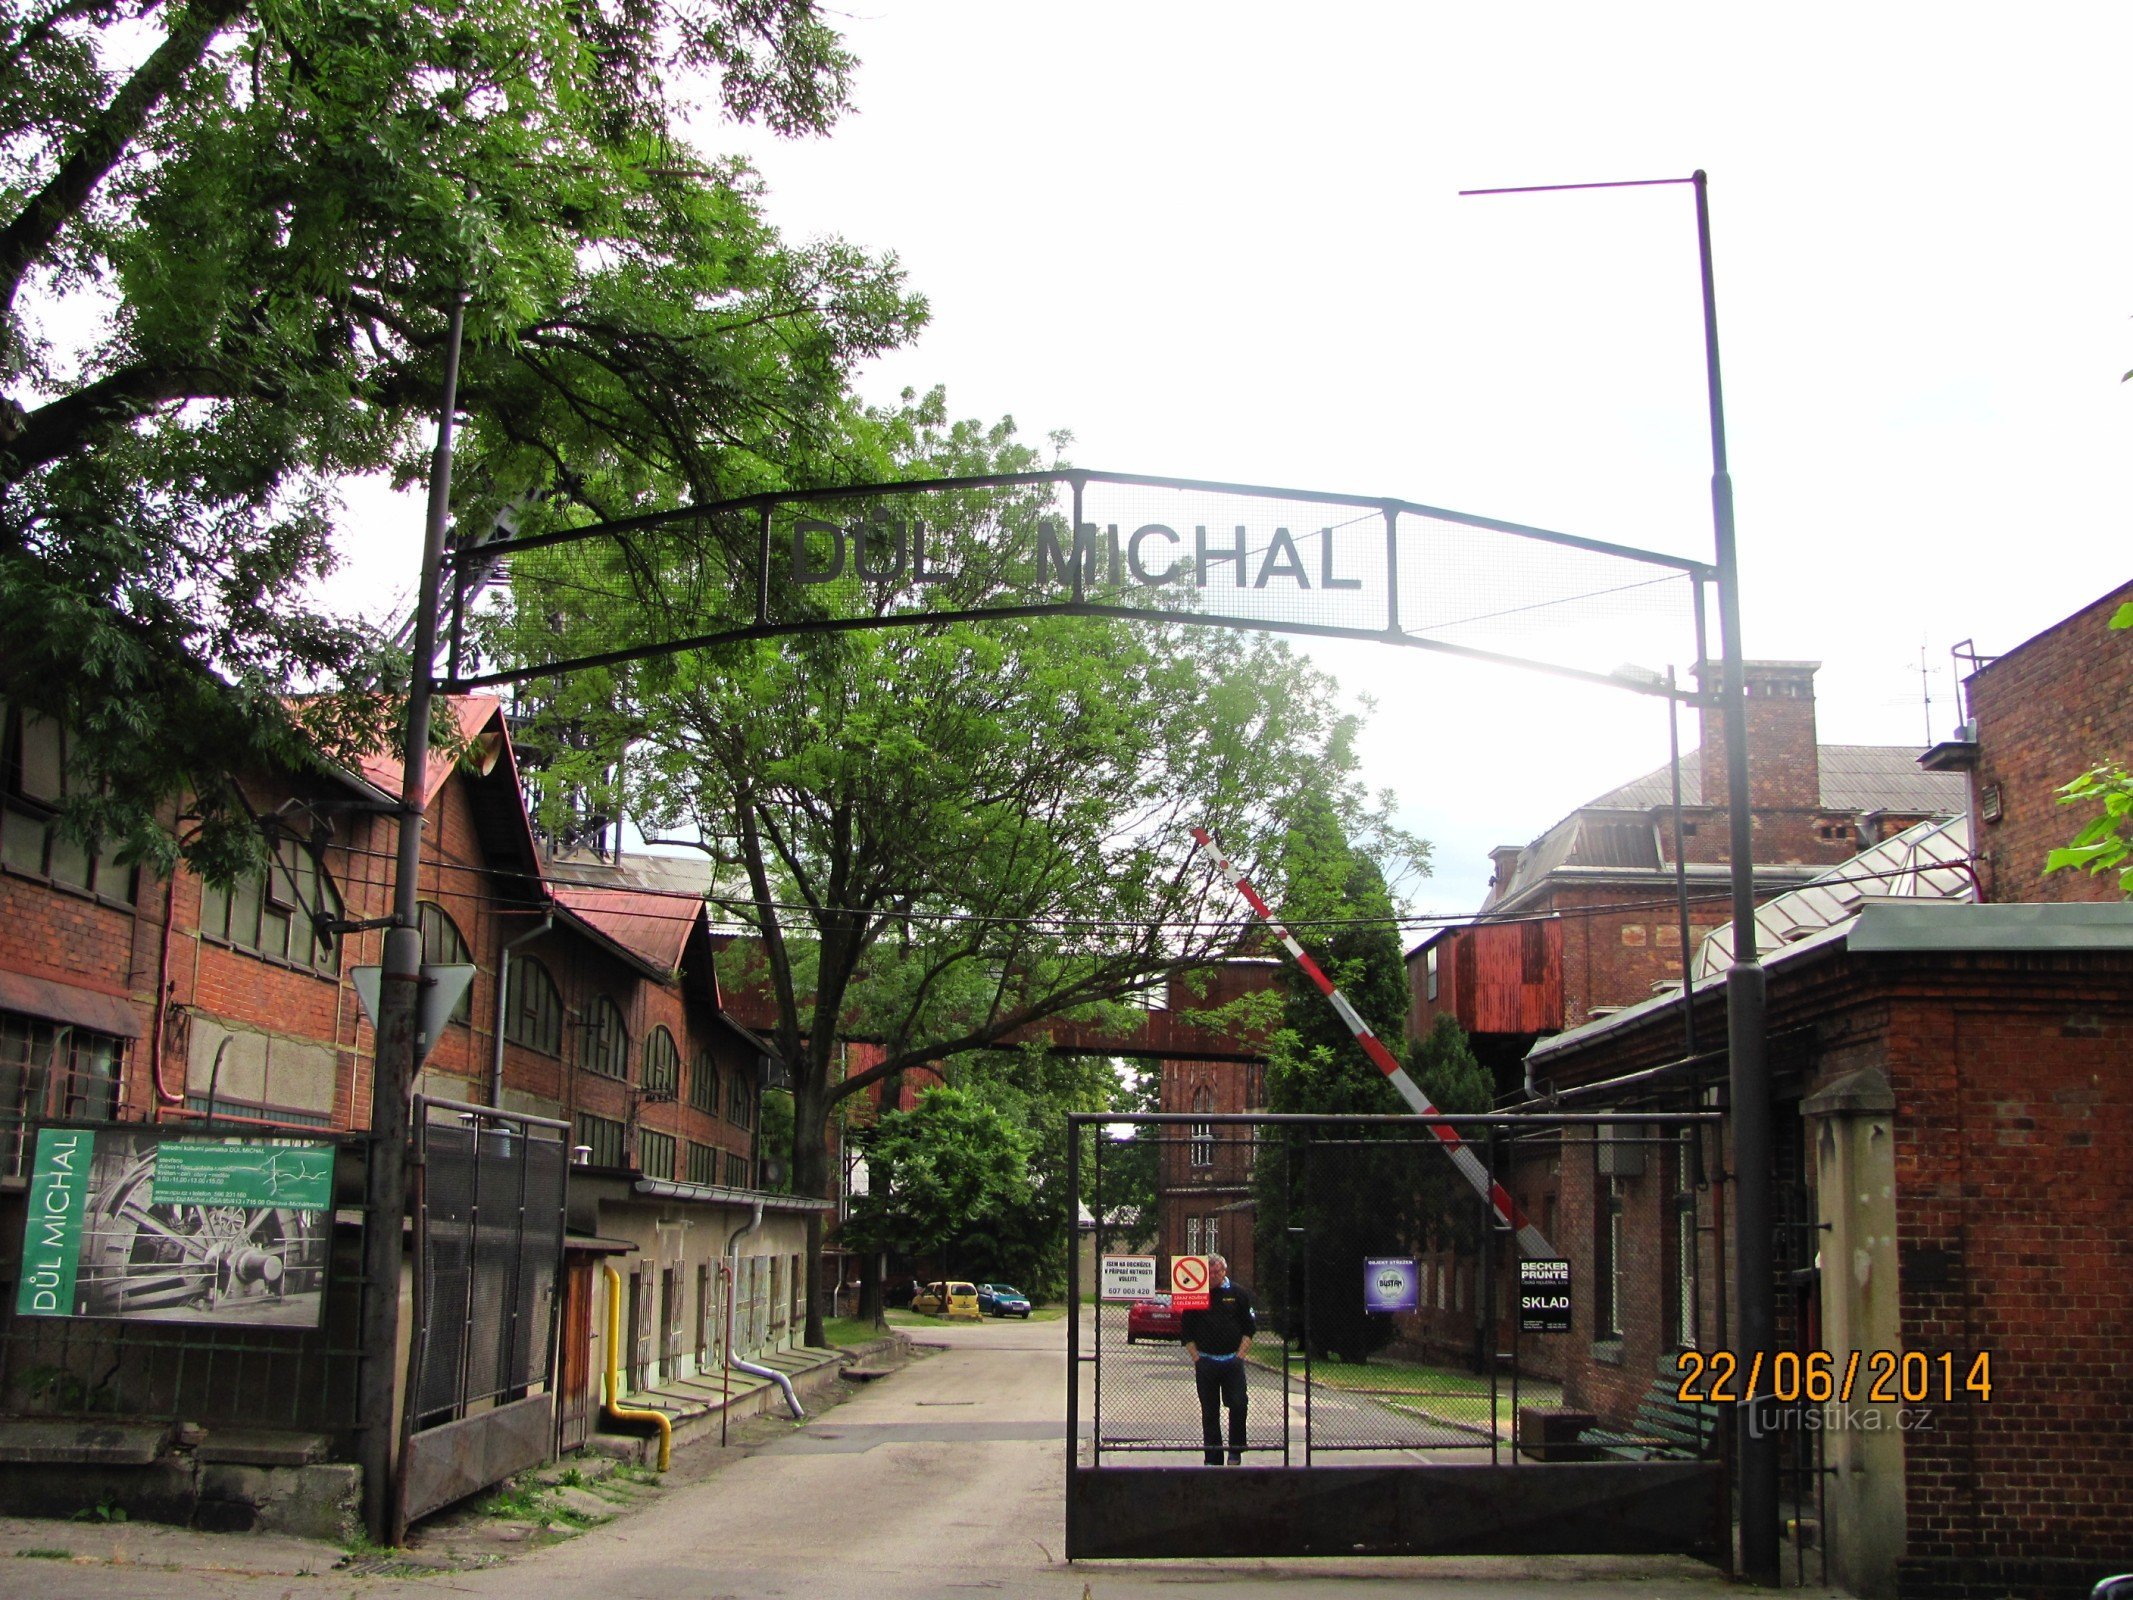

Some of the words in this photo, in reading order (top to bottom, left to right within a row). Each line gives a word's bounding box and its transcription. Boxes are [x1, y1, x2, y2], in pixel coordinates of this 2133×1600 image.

[793, 508, 958, 584] DŮL
[1036, 521, 1362, 590] MICHAL
[41, 1136, 78, 1247] MICHAL
[29, 1256, 62, 1310] DŮL
[1521, 1262, 1568, 1271] BECKER
[1522, 1296, 1569, 1308] SKLAD
